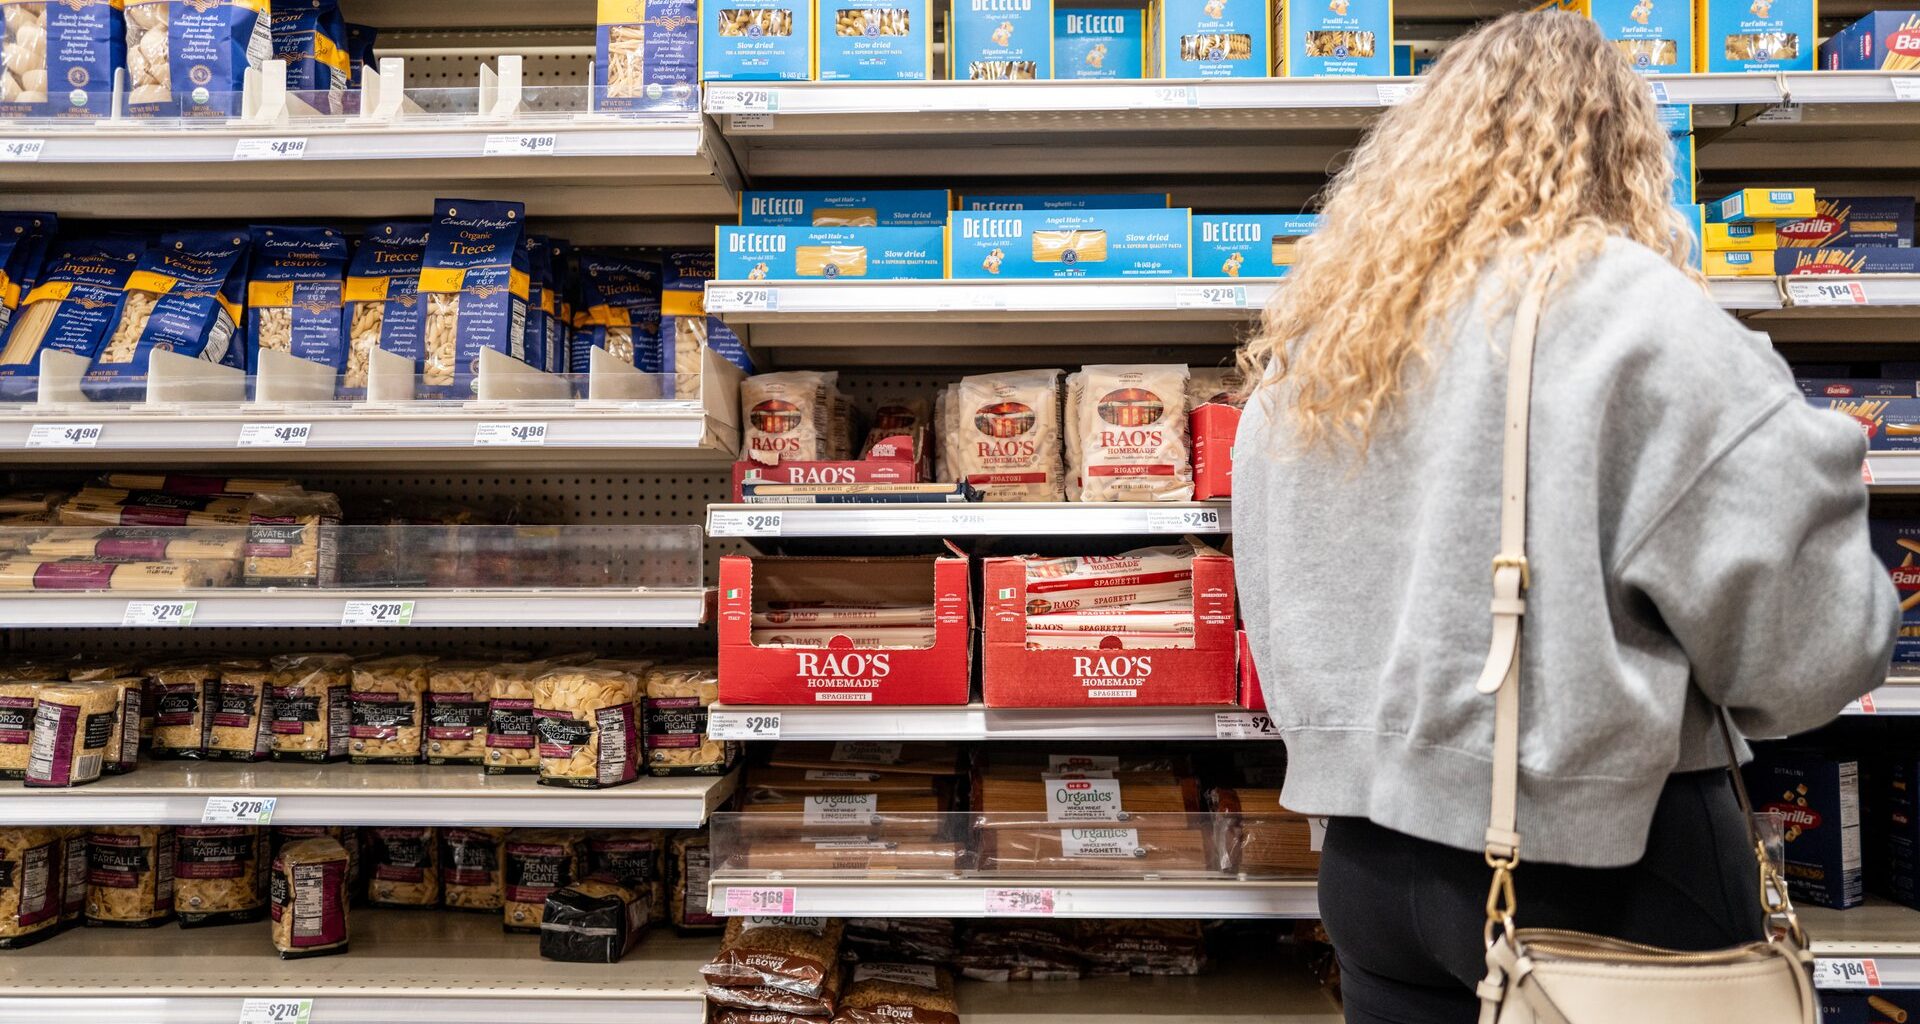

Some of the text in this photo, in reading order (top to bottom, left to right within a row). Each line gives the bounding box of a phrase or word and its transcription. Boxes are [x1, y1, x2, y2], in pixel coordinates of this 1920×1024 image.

[1067, 15, 1124, 34] DE CECCO
[854, 41, 891, 49] Slow dried
[737, 91, 767, 105] $278
[752, 198, 803, 215] DE CECCO
[963, 218, 1022, 238] DE CECCO
[1203, 222, 1260, 242] DE CECCO
[1782, 220, 1833, 232] Barilla
[460, 231, 492, 240] Organic
[729, 233, 786, 252] DE CECCO
[450, 242, 495, 255] Trecce
[374, 250, 418, 263] Trecce
[736, 291, 767, 305] $278
[1203, 288, 1234, 302] $278
[1818, 285, 1850, 299] $184
[65, 428, 98, 442] $498
[275, 427, 307, 440] $498
[512, 425, 544, 440] $498
[1100, 431, 1162, 447] RAO'S
[977, 441, 1034, 457] RAO'S
[747, 516, 780, 530] $286
[1184, 513, 1217, 526] $286
[1094, 577, 1140, 586] SPAGHETTI
[1053, 599, 1080, 609] RAO'S
[1094, 594, 1137, 604] SPAGHETTI
[152, 605, 183, 620] $278
[371, 604, 401, 619] $278
[796, 653, 890, 676] RAO'S
[1073, 656, 1152, 676] RAO'S
[222, 700, 246, 708] ORZO
[490, 715, 535, 727] ORECCHIET
[500, 720, 532, 733] RIGATE
[746, 717, 779, 732] $286
[1252, 717, 1276, 732] $2
[1056, 789, 1113, 804] Organics
[231, 801, 261, 817] $278
[1072, 827, 1128, 841] Organics
[193, 846, 246, 855] FARFALLE
[93, 855, 140, 865] FARFALLE
[524, 864, 558, 873] PENNE
[523, 872, 559, 883] RIGATE
[752, 892, 783, 908] $168
[745, 958, 783, 968] ELBOWS
[1833, 963, 1864, 980] $184
[268, 1004, 298, 1021] $278
[749, 1013, 787, 1022] ELBOWS
[877, 1009, 913, 1017] ELBOWS
